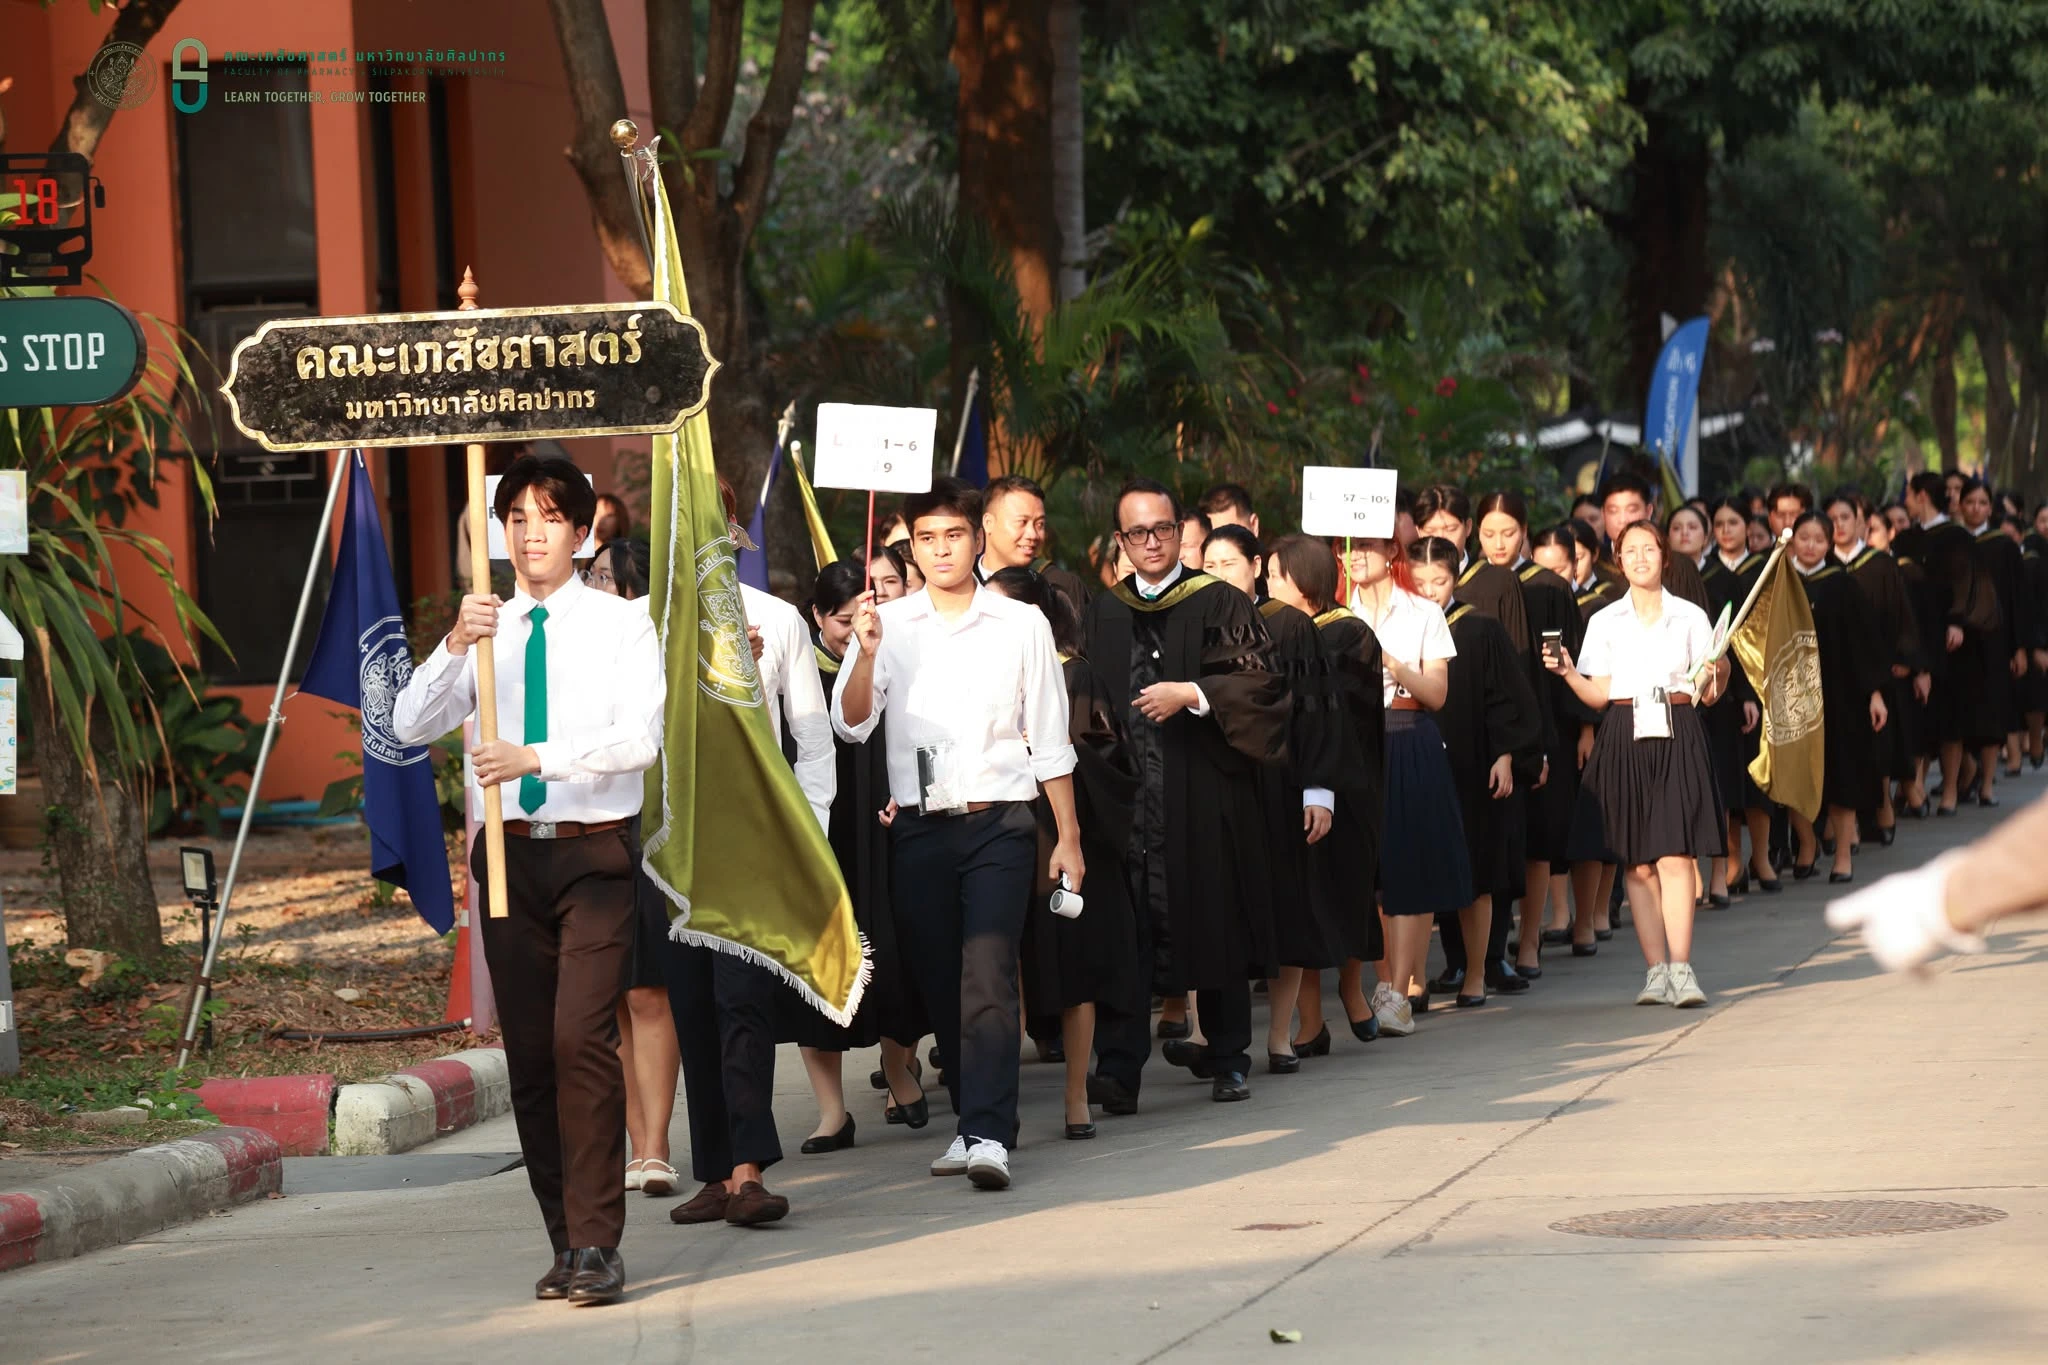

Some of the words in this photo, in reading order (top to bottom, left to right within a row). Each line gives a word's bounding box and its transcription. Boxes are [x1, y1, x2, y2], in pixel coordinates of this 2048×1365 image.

[13, 178, 59, 226] 18
[22, 332, 105, 372] STOP
[296, 313, 643, 379] คณะเภสัชศาสตร์
[345, 387, 595, 420] มหาวิทยาลัยศิลปากร
[883, 462, 893, 473] 9
[1353, 511, 1366, 520] 10
